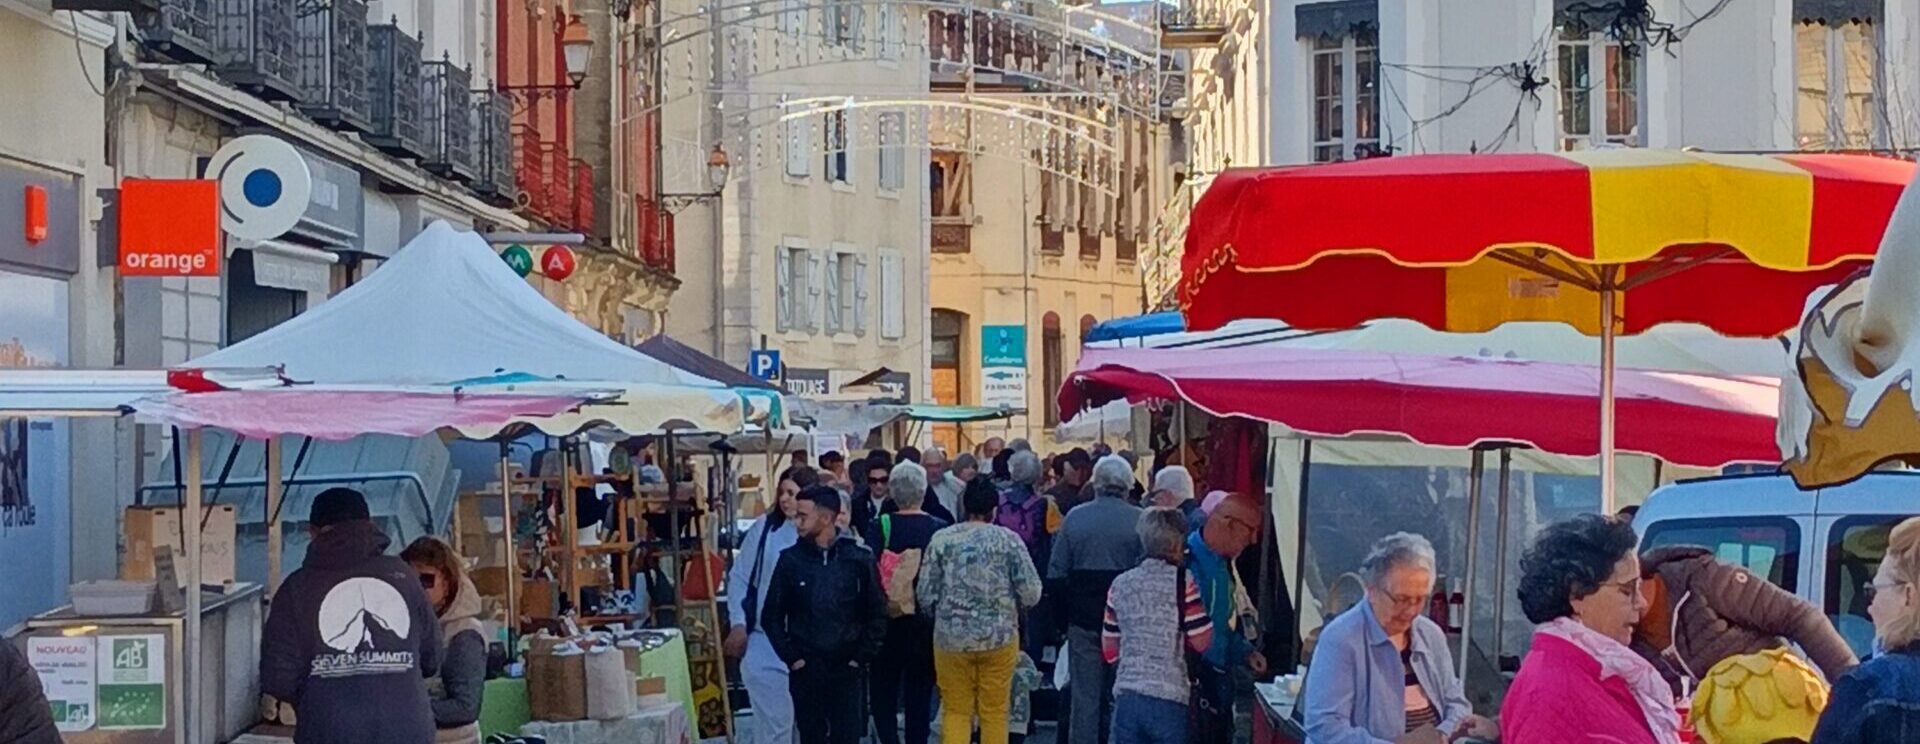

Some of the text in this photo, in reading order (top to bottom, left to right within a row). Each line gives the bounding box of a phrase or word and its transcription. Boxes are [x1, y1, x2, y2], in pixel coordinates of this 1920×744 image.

[126, 252, 206, 274] orange
[548, 252, 566, 271] A
[757, 354, 773, 376] P
[116, 646, 143, 668] AB
[310, 650, 414, 673] SEVEN SUMMITS
